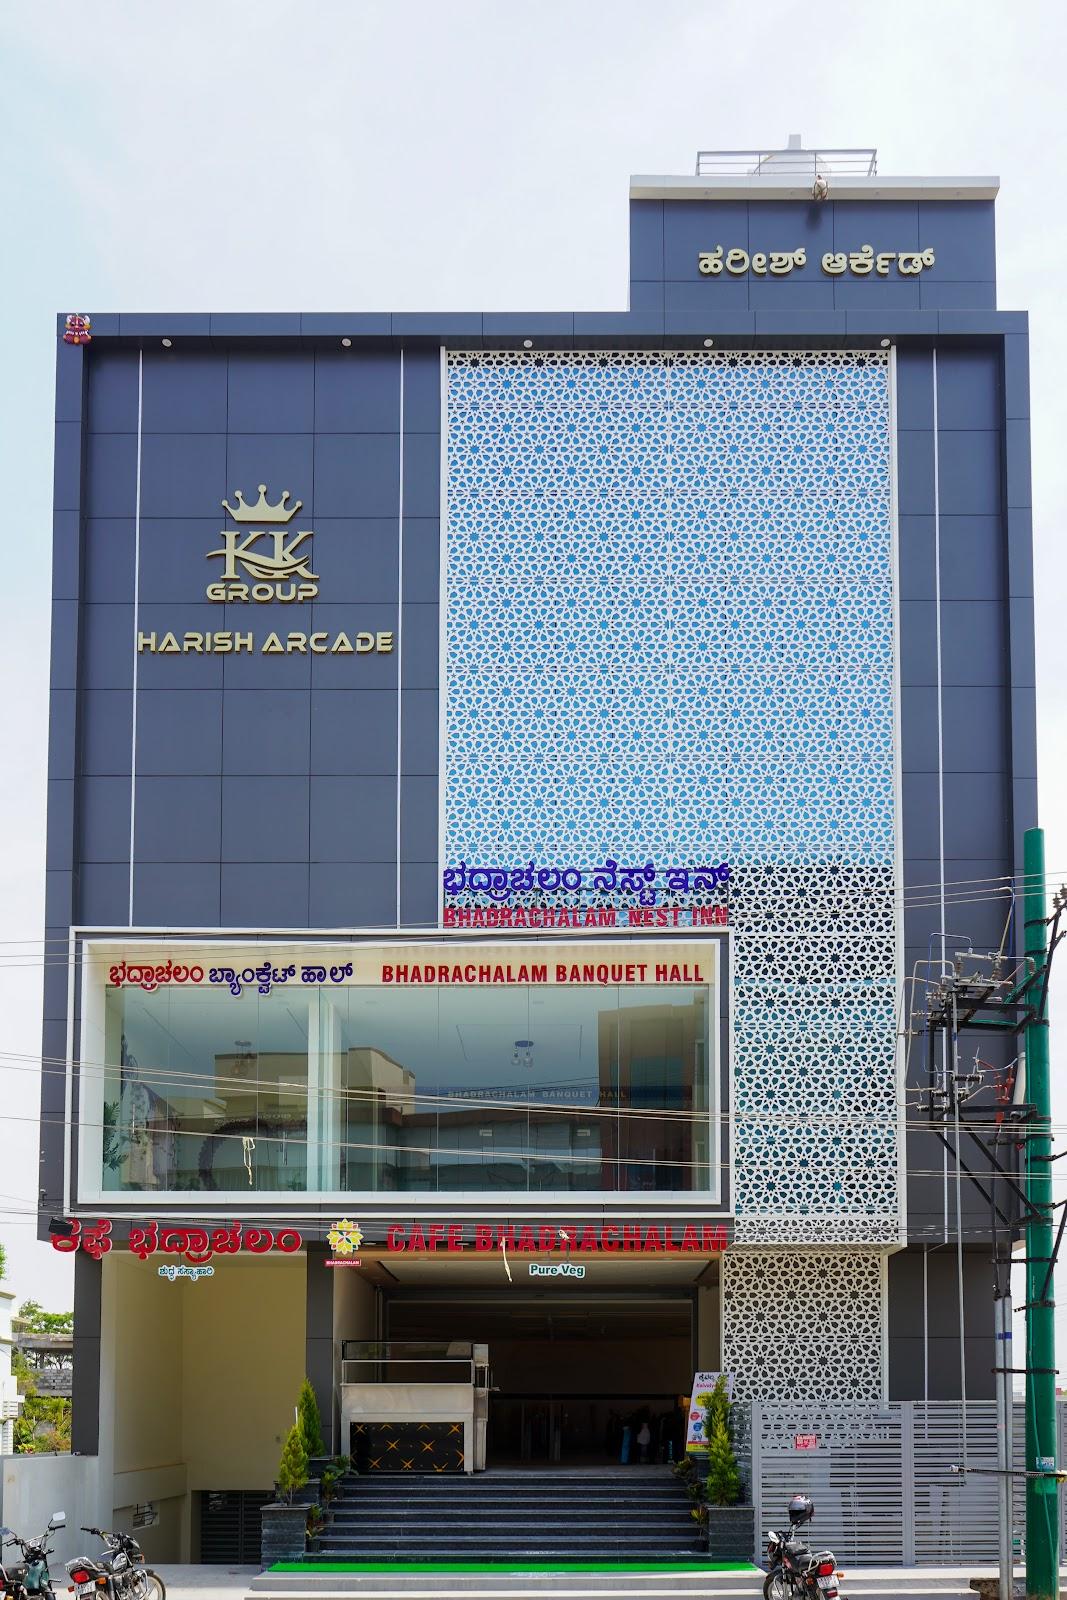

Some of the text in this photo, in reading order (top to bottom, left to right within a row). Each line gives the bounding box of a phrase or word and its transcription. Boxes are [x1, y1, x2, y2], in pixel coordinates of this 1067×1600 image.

[206, 531, 320, 579] KK
[206, 583, 319, 602] GROUP
[137, 631, 393, 652] HARISH ARCADE
[443, 860, 582, 901] ಭದ್ರಾಚಲಂ
[443, 905, 729, 928] BHADRACHALAM NEST INN
[109, 960, 204, 990] ಭದ್ರಾಚಲಂ
[301, 962, 353, 983] ಹಾಲ್
[382, 964, 704, 985] BHADRACHALAM BANQUET HALL
[542, 1090, 593, 1099] BANQUET
[129, 1218, 303, 1263] ಭದ್ರಾಚಲಂ
[387, 1224, 729, 1252] CAFE BHADRACHALAM
[530, 1264, 584, 1277] Pure Veg
